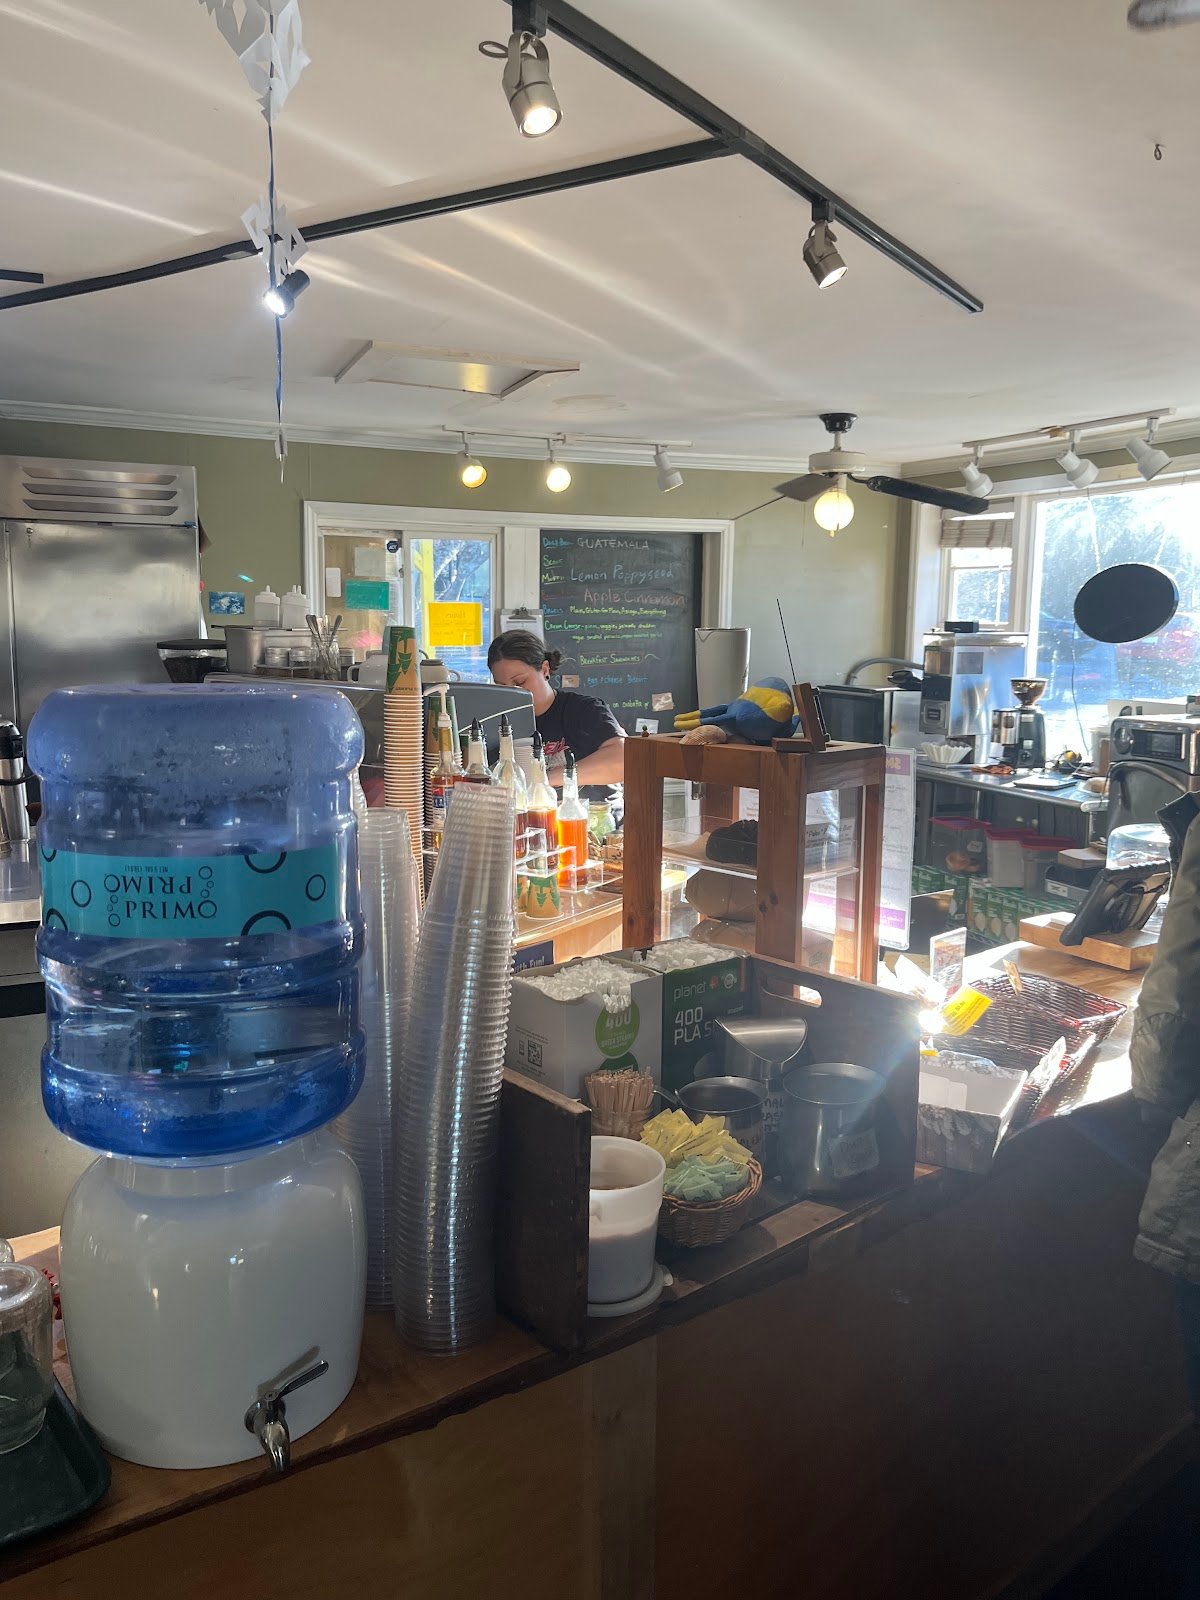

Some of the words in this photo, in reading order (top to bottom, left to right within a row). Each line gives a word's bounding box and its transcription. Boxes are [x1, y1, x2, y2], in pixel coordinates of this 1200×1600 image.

[577, 537, 650, 550] GUATEMALA
[570, 567, 607, 582] Lemon
[613, 564, 674, 584] Poppyseed
[584, 588, 621, 605] Apple
[103, 873, 192, 895] PRIMO
[125, 899, 218, 919] PRIMO
[673, 981, 706, 1002] planet
[675, 1006, 703, 1027] 400
[674, 1023, 702, 1046] PLA
